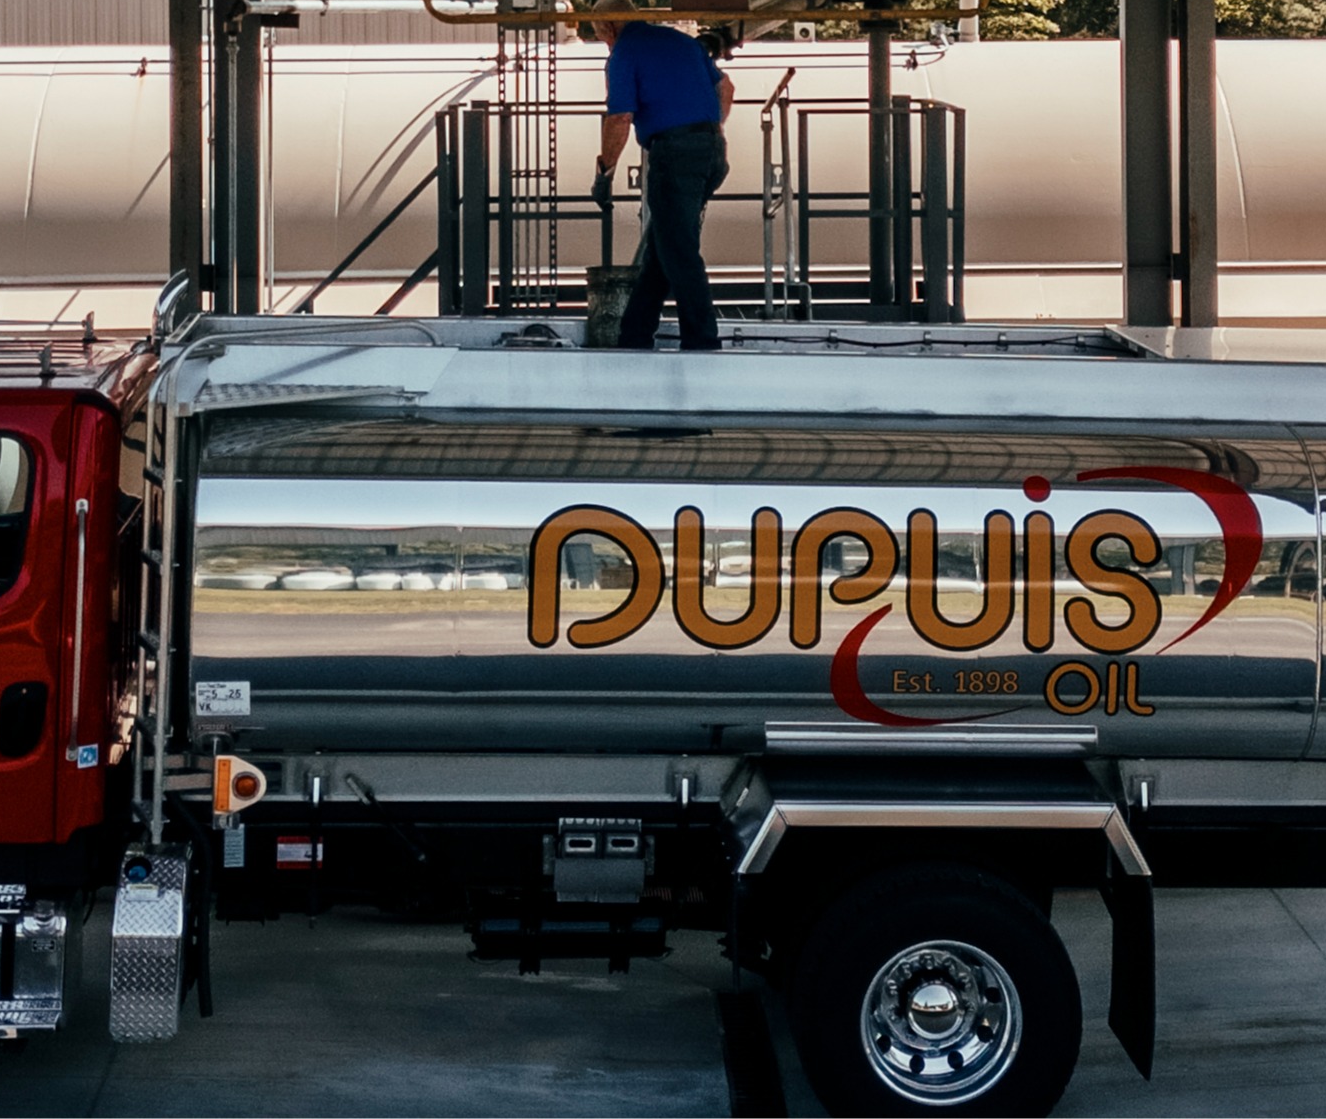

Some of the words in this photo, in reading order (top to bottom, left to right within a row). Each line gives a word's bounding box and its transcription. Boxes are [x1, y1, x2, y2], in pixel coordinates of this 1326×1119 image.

[892, 670, 941, 693] Est.
[954, 671, 1018, 693] 1898
[1043, 660, 1156, 716] OIL
